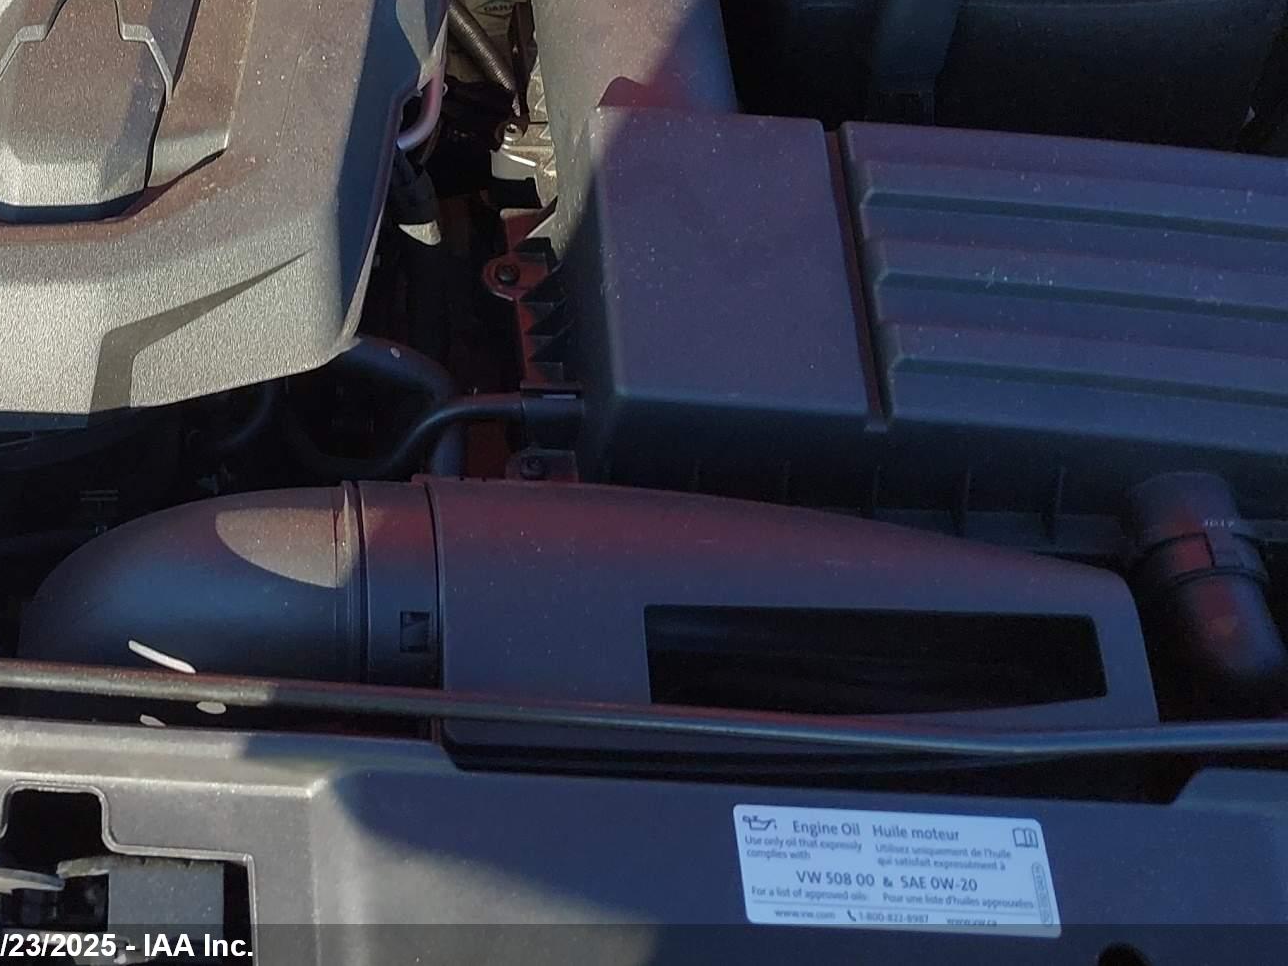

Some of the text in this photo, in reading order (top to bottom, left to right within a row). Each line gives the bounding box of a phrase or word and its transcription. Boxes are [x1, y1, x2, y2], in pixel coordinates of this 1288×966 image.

[792, 820, 860, 836] Engine Oil
[871, 824, 959, 840] Huile moteur
[744, 836, 862, 853] Use only oil that expressly
[745, 847, 811, 861] complies with
[796, 871, 978, 891] VW 508 00 & SAE 0W-20
